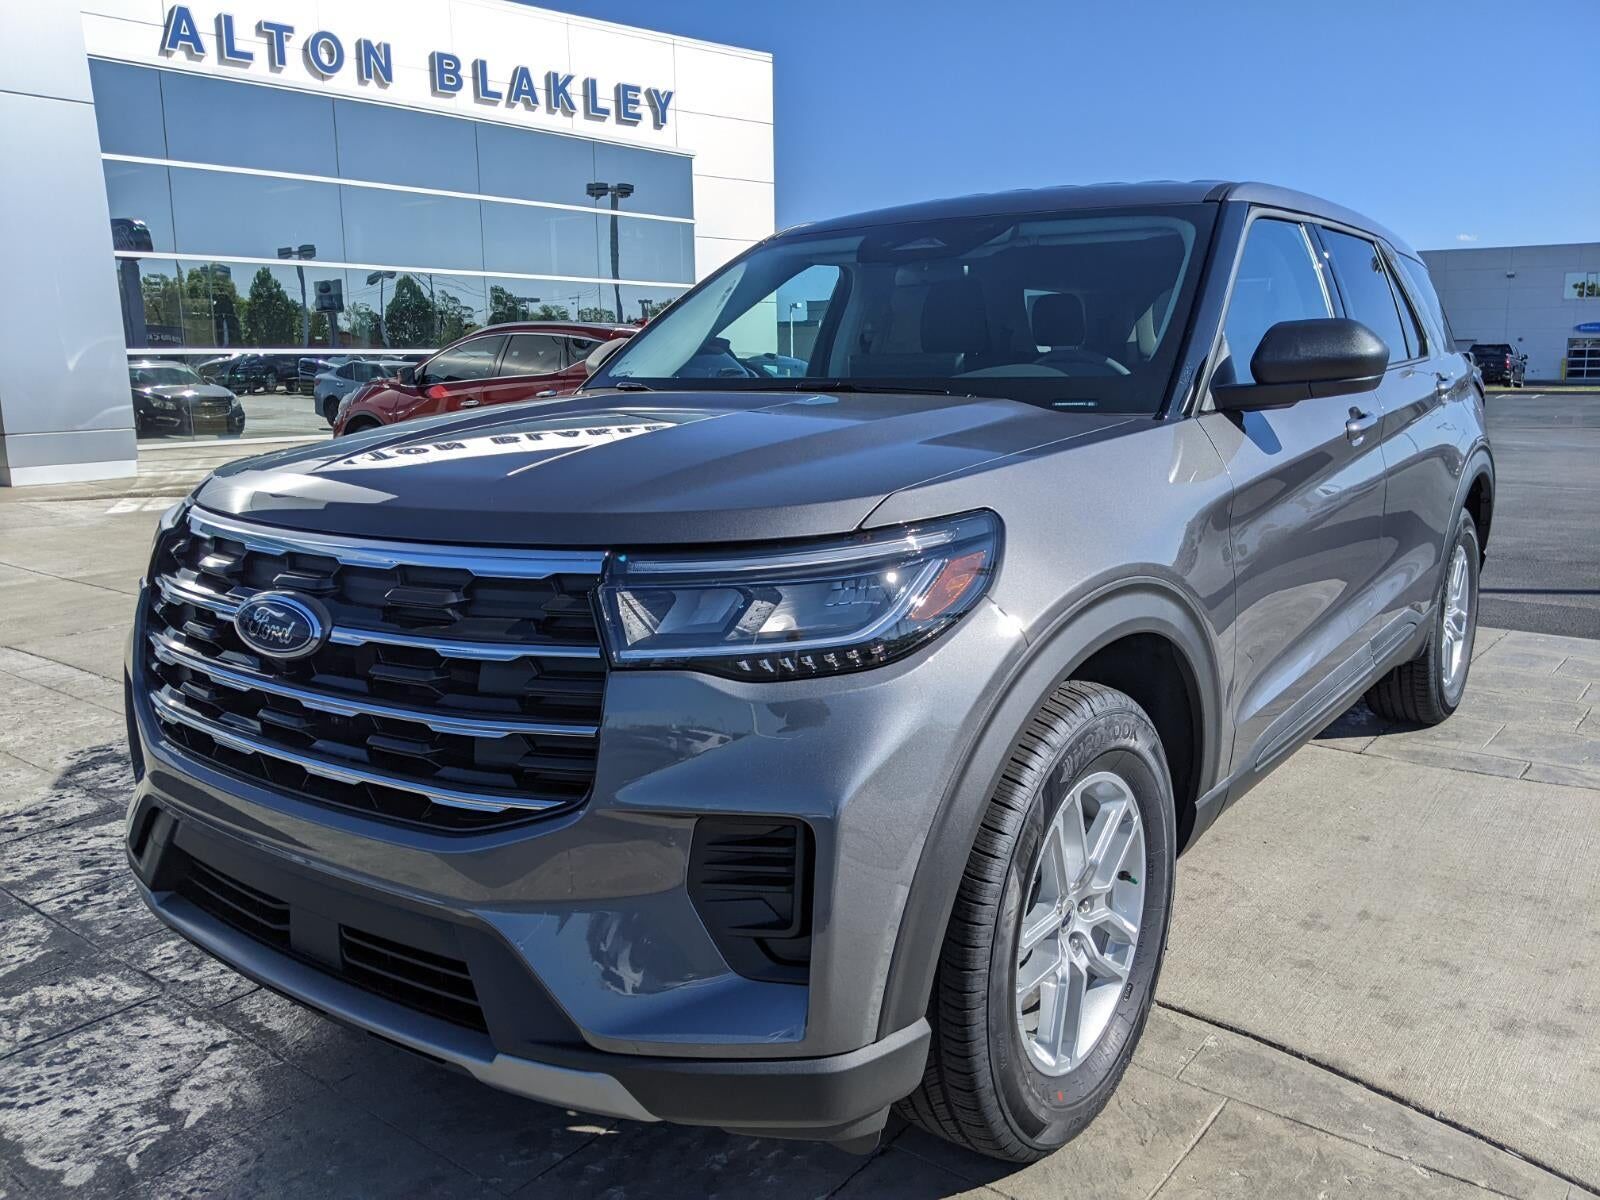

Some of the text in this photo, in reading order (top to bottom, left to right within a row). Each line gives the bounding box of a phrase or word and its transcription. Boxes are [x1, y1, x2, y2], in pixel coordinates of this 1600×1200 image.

[161, 4, 674, 128] ALTON BLAKLEY
[248, 606, 296, 645] Ford
